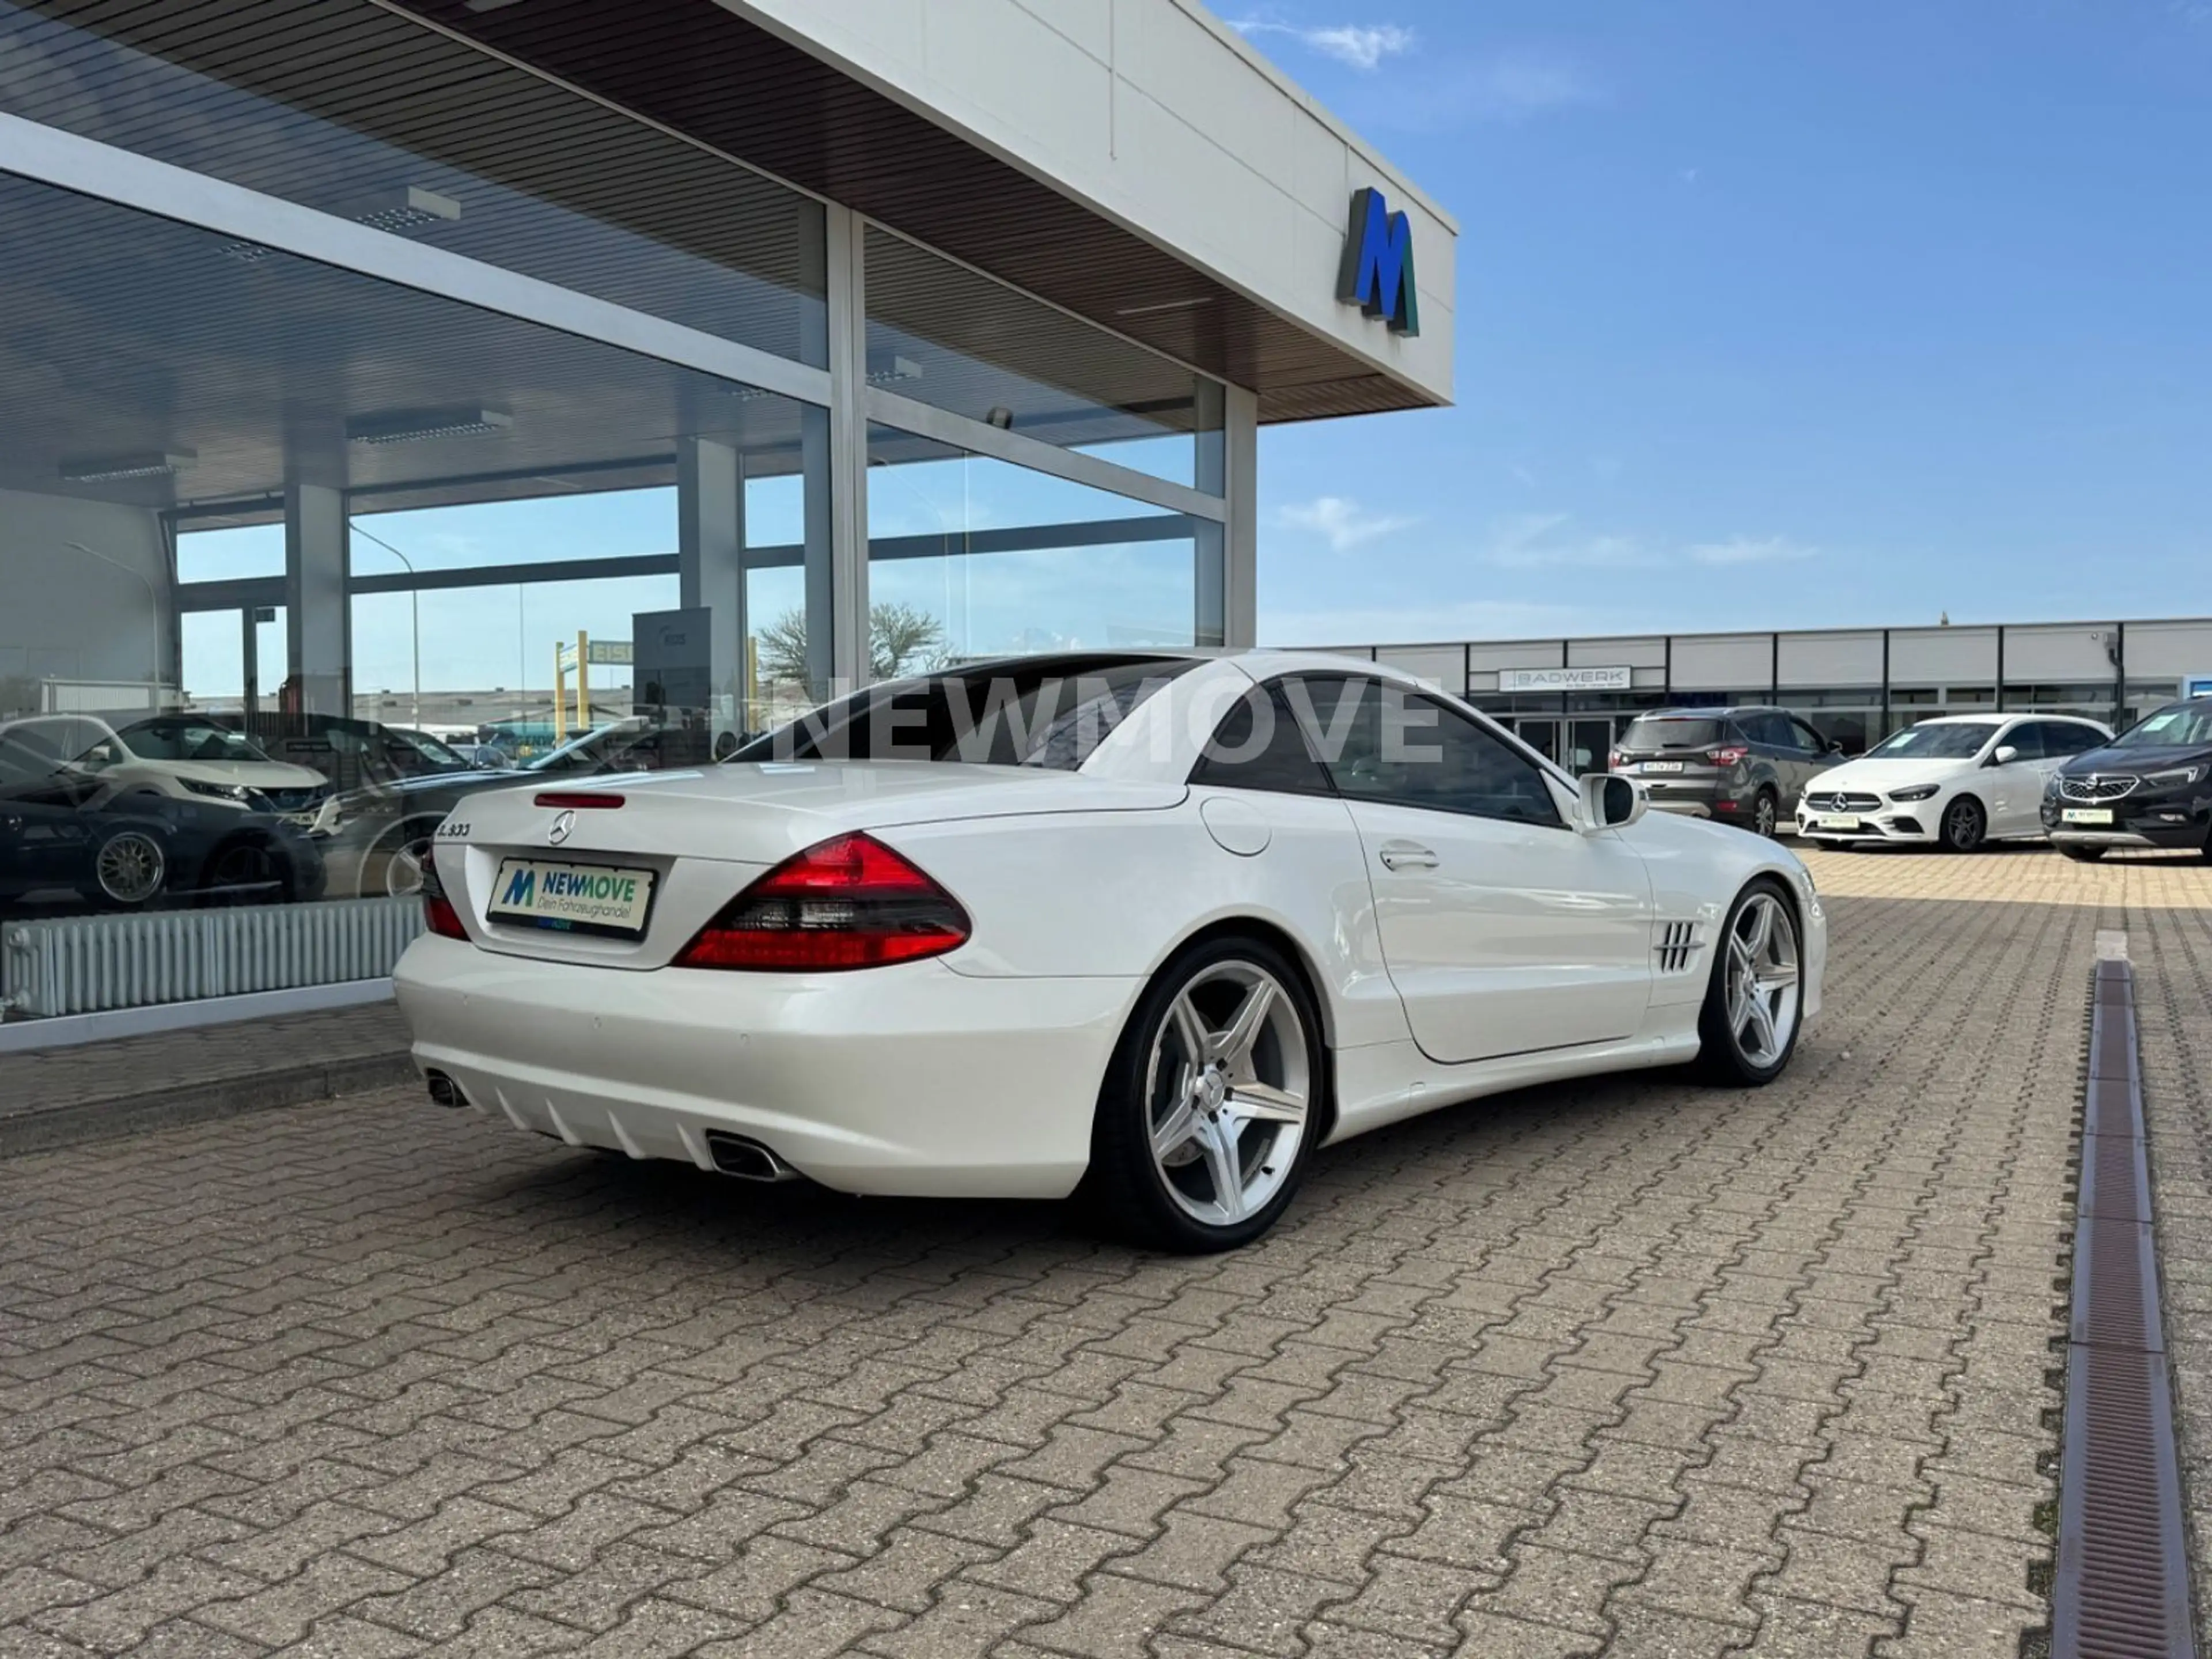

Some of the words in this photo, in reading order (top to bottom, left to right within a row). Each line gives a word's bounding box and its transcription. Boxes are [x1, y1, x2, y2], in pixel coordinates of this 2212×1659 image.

[1335, 186, 1419, 338] M
[542, 871, 637, 903] NEWMOVE
[537, 896, 556, 911] Dein
[558, 898, 631, 919] Fahrzeughandel
